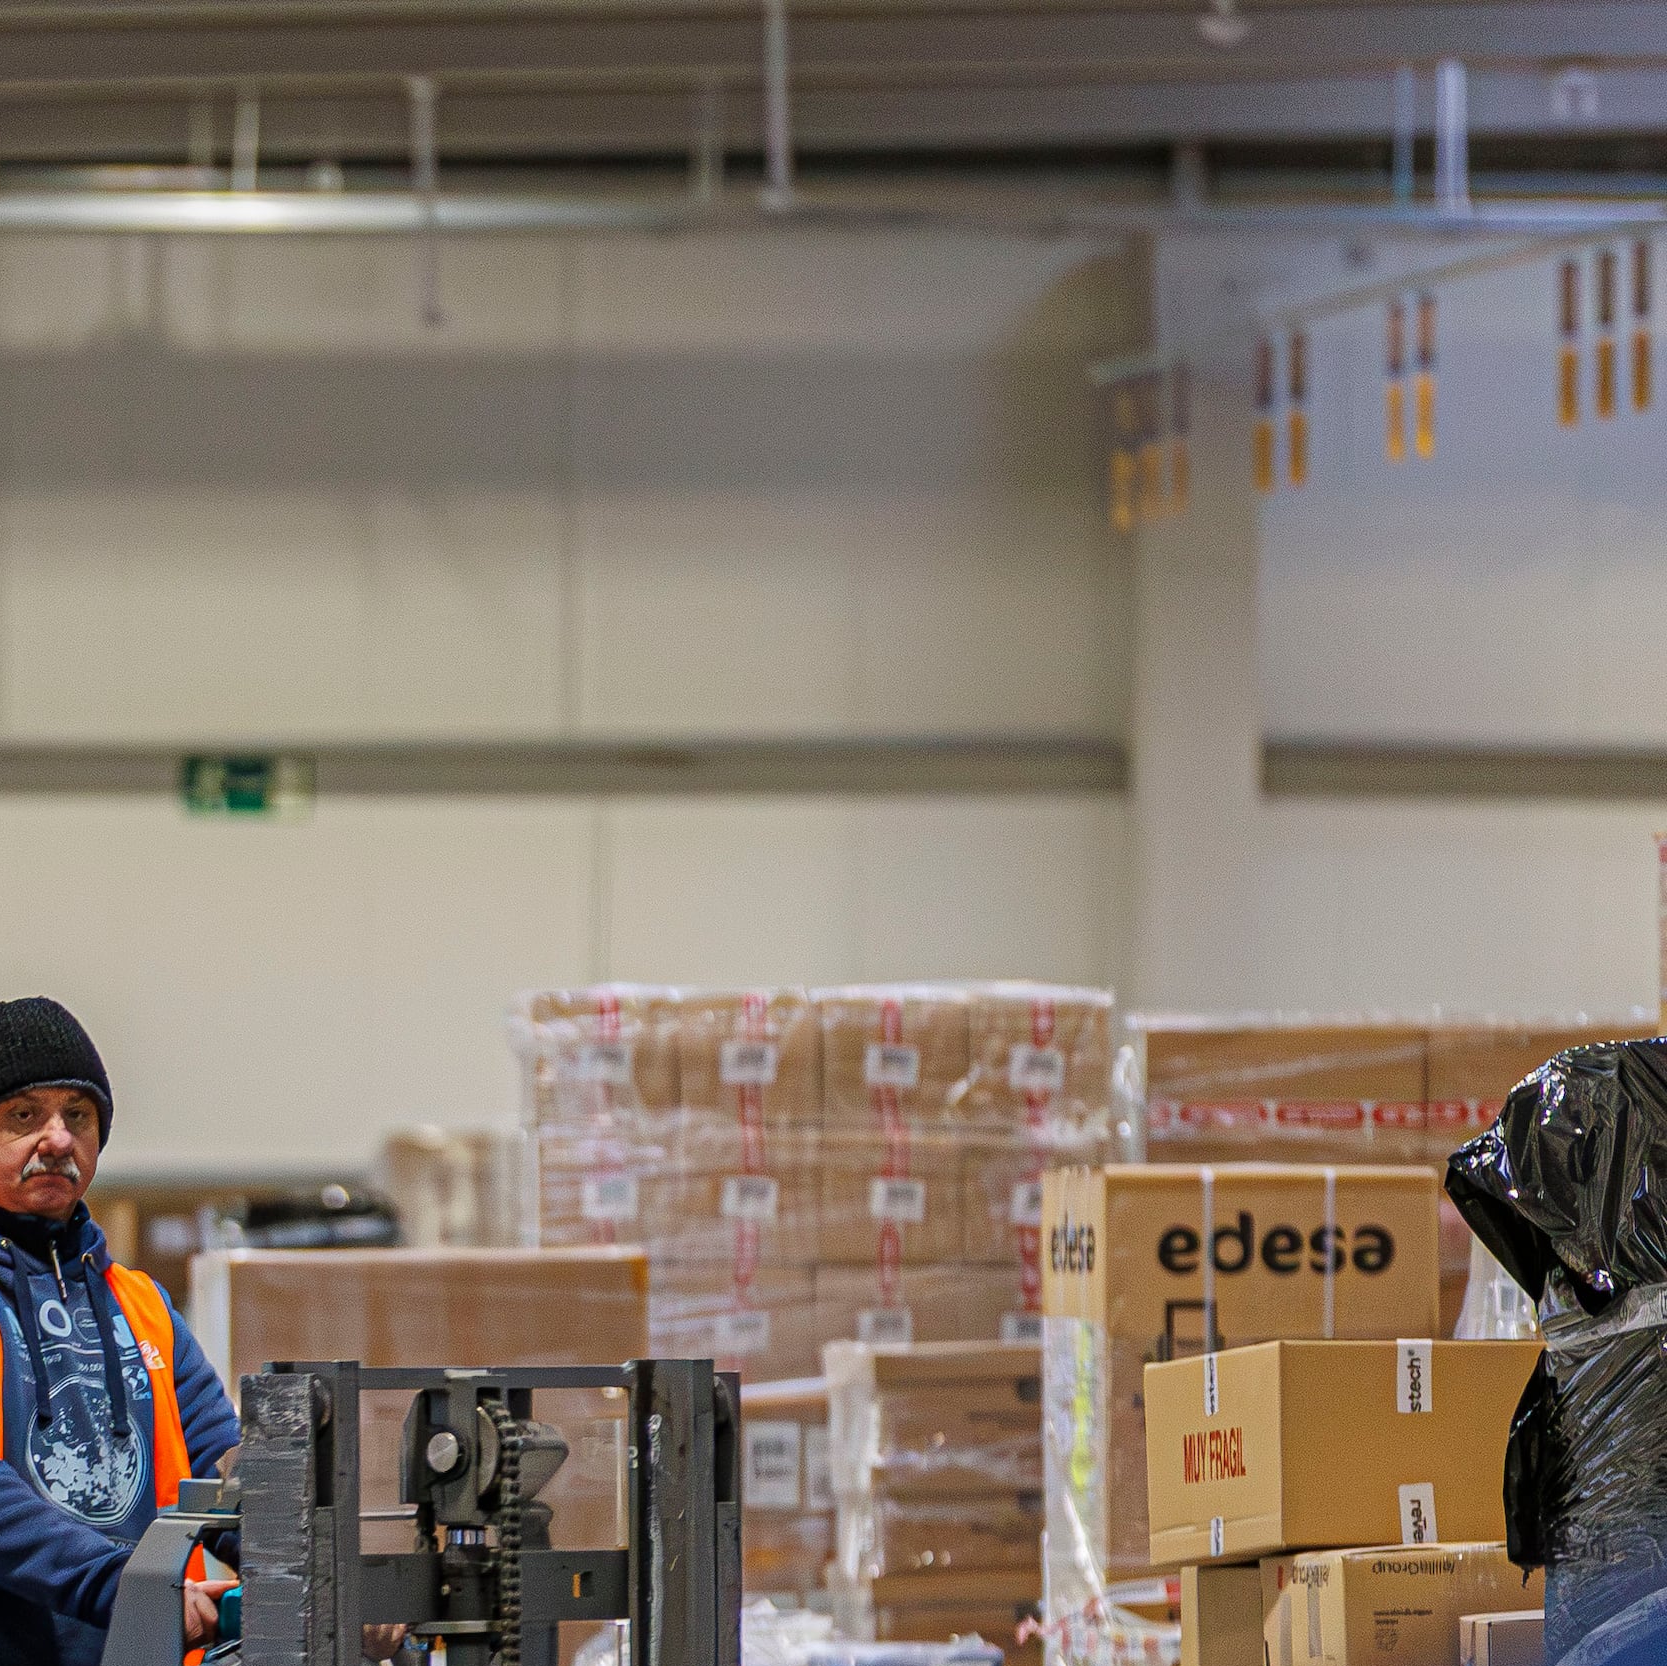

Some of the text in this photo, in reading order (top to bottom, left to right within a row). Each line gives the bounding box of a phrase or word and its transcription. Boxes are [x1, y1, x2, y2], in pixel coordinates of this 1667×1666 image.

[1051, 1209, 1096, 1274] edesa
[1158, 1210, 1395, 1275] edesa
[1183, 1426, 1246, 1484] MUY FRAGIL
